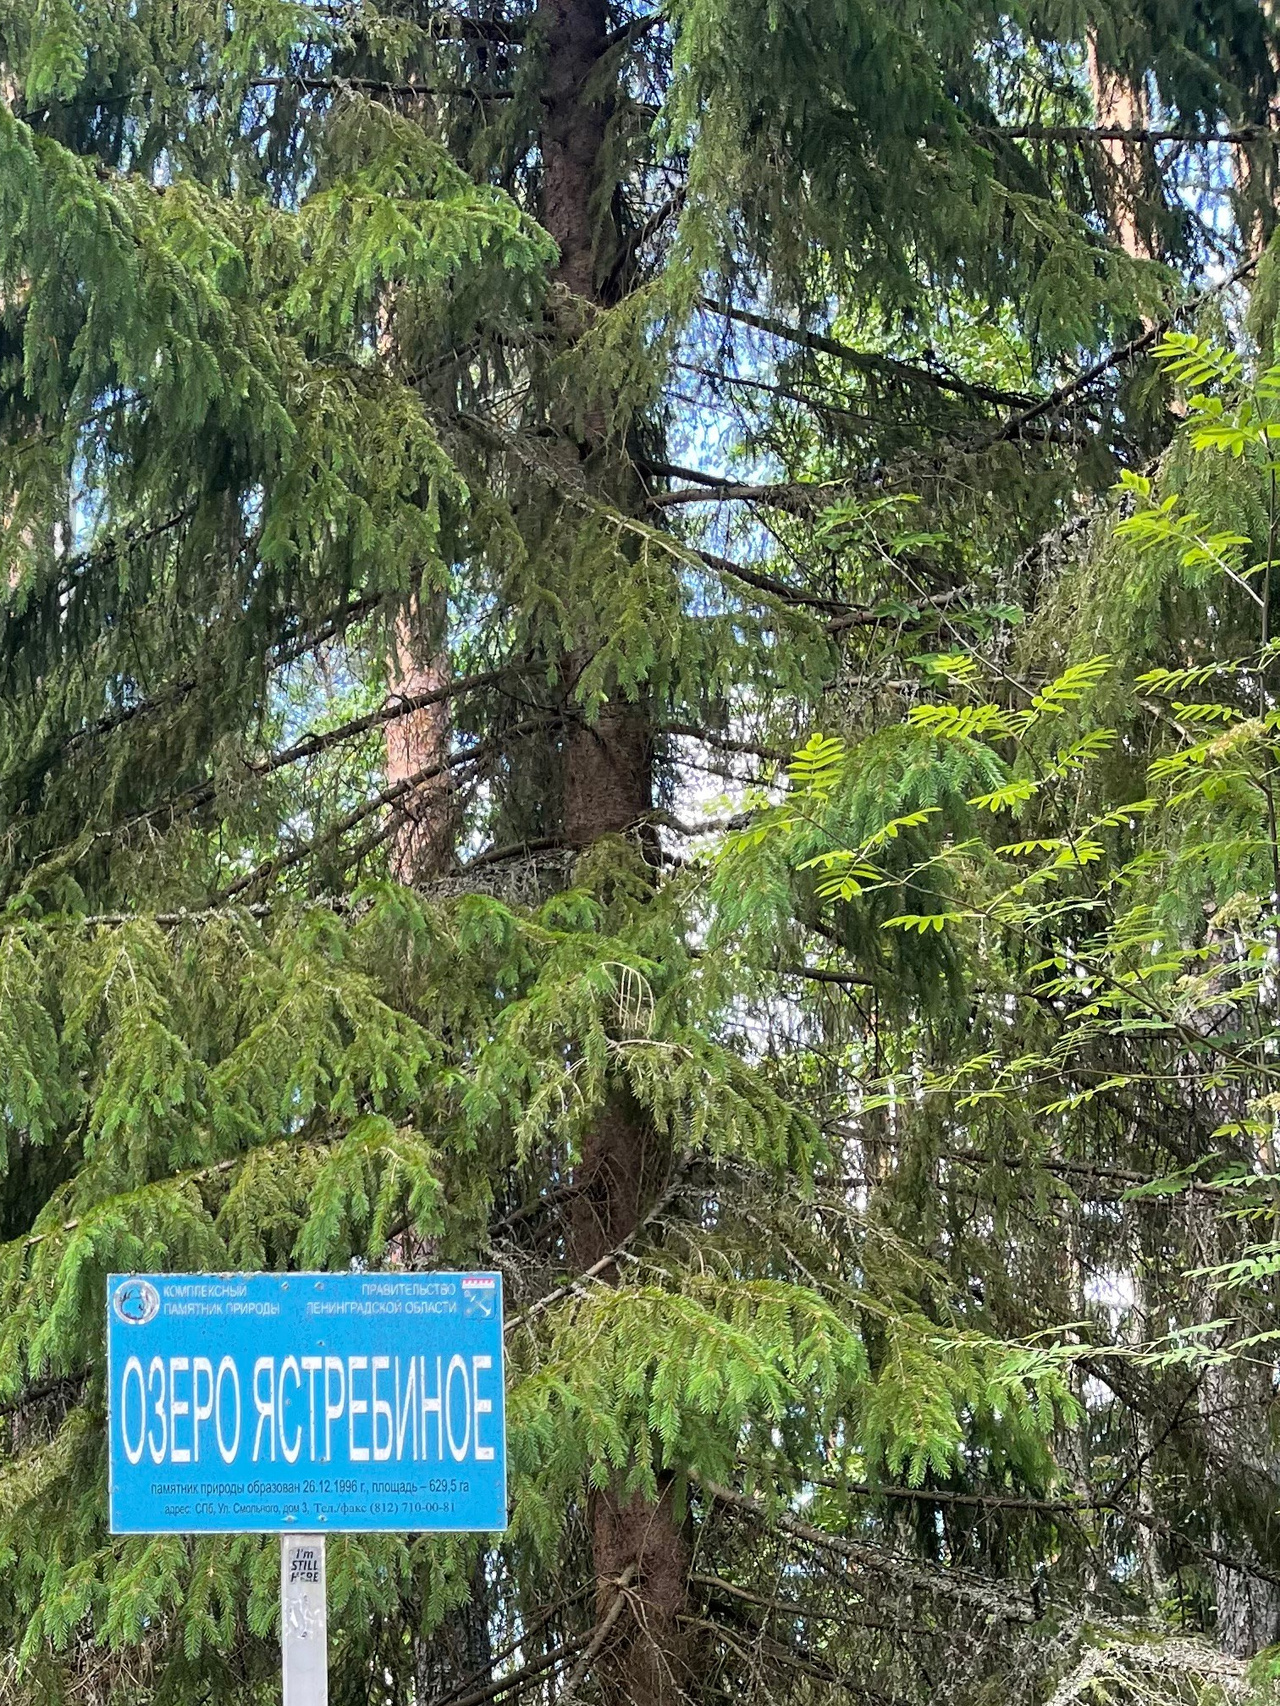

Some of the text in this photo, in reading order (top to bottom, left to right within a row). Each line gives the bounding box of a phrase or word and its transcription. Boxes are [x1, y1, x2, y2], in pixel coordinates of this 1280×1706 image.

[163, 1284, 247, 1297] КОМПЛЕКСНЫЙ
[361, 1283, 456, 1296] ПРАВИТЕЛЬСТВО
[163, 1302, 281, 1316] ПАМЯТНИК ПРИРОДЫ
[306, 1300, 457, 1315] ЛЕНИНГРАДСКОЙ ОБЛАСТИ
[121, 1354, 495, 1465] ОЗЕРО ЯСТРЕБИНОЕ
[151, 1482, 199, 1494] памятник
[200, 1482, 245, 1496] природы
[247, 1480, 301, 1496] образован
[302, 1479, 358, 1494] 26.12.1996
[371, 1480, 418, 1495] площадь
[429, 1479, 457, 1494] 629,5
[459, 1481, 469, 1492] га
[164, 1504, 192, 1516] адрес:
[195, 1502, 216, 1516] СПб,
[233, 1502, 281, 1515] Смольного,
[282, 1503, 300, 1515] дом
[313, 1502, 367, 1515] Тел./факс
[369, 1502, 399, 1515] (812)
[402, 1502, 455, 1514] 710-00-81
[295, 1548, 314, 1559] I'm
[291, 1560, 319, 1571] STILL
